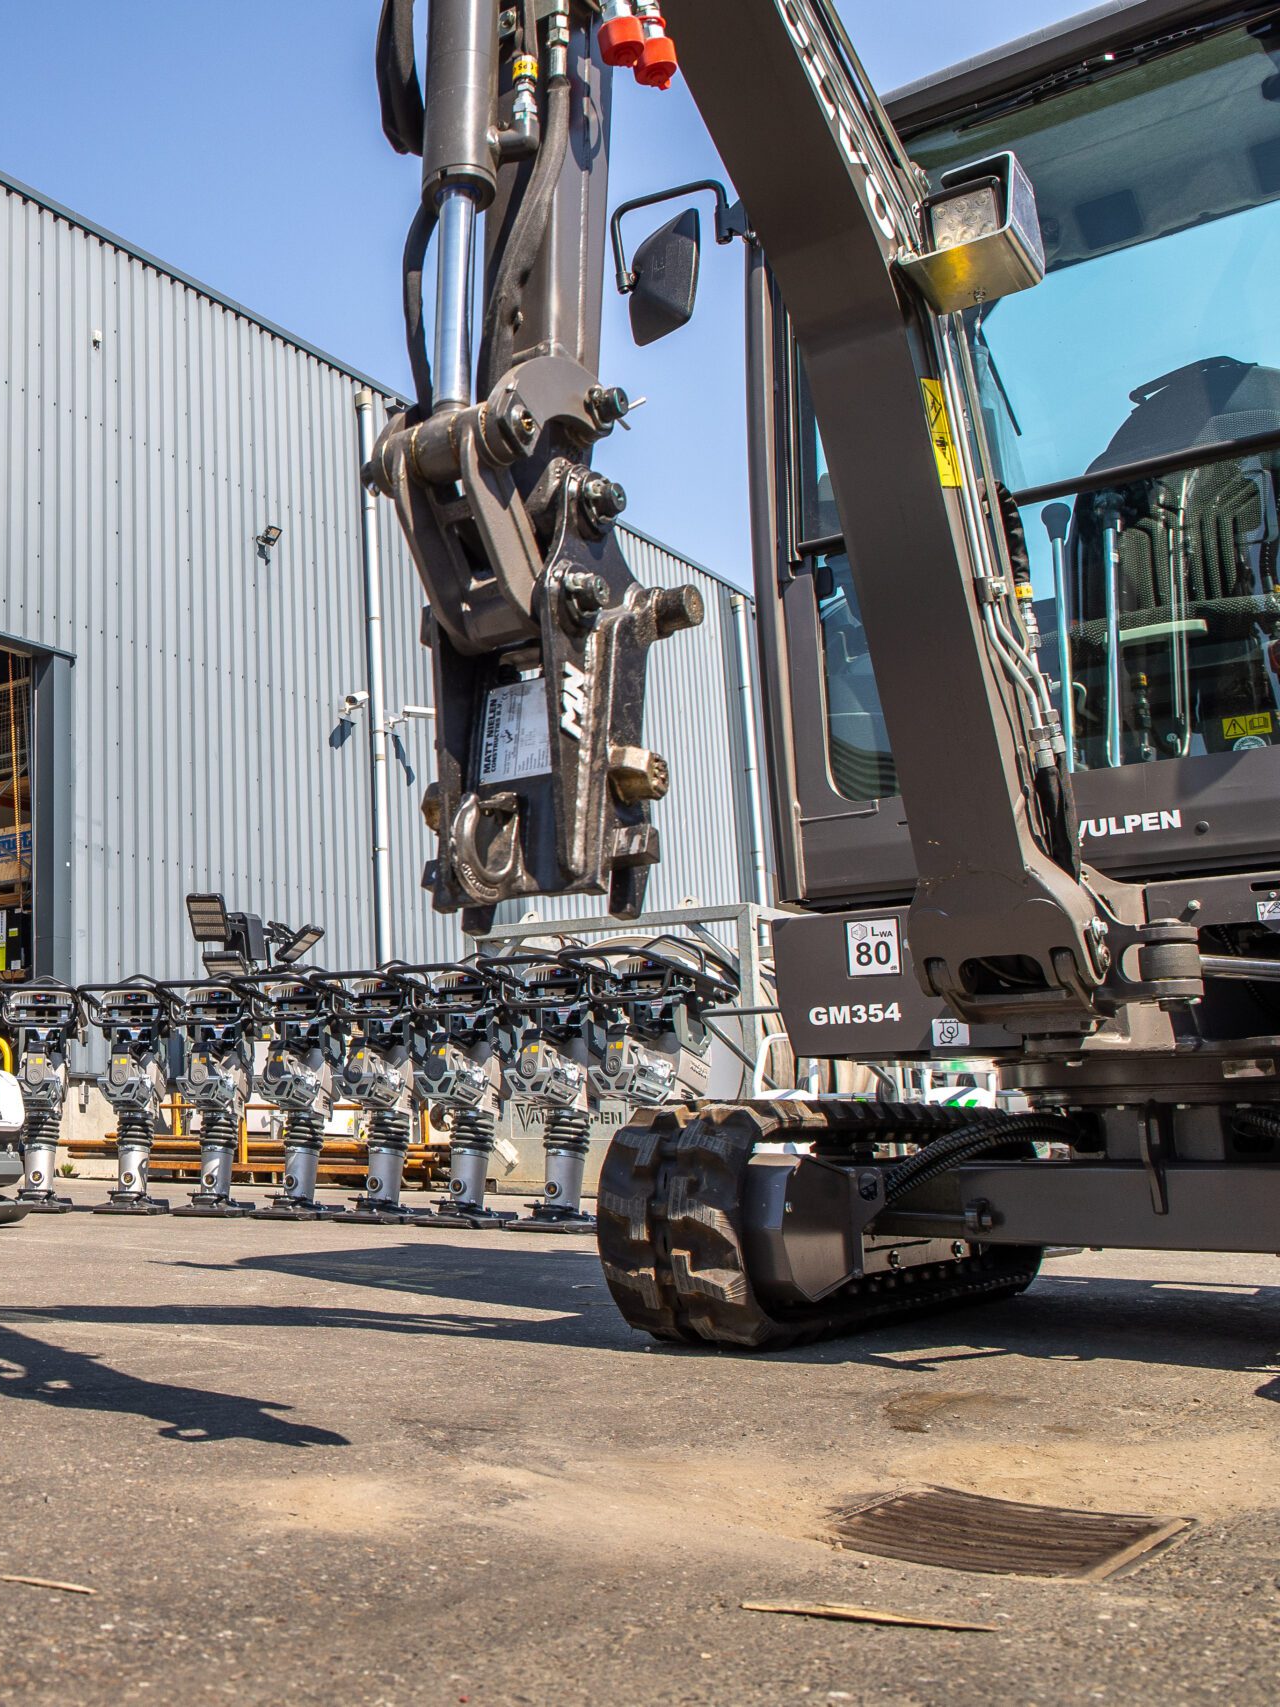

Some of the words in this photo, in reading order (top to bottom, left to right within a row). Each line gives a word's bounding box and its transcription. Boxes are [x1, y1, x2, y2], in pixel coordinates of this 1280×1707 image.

[486, 698, 498, 739] NIELEN
[483, 741, 494, 775] MATT
[490, 717, 501, 773] CONSTRUCTIES
[856, 940, 891, 966] 80
[808, 1002, 902, 1026] GM354
